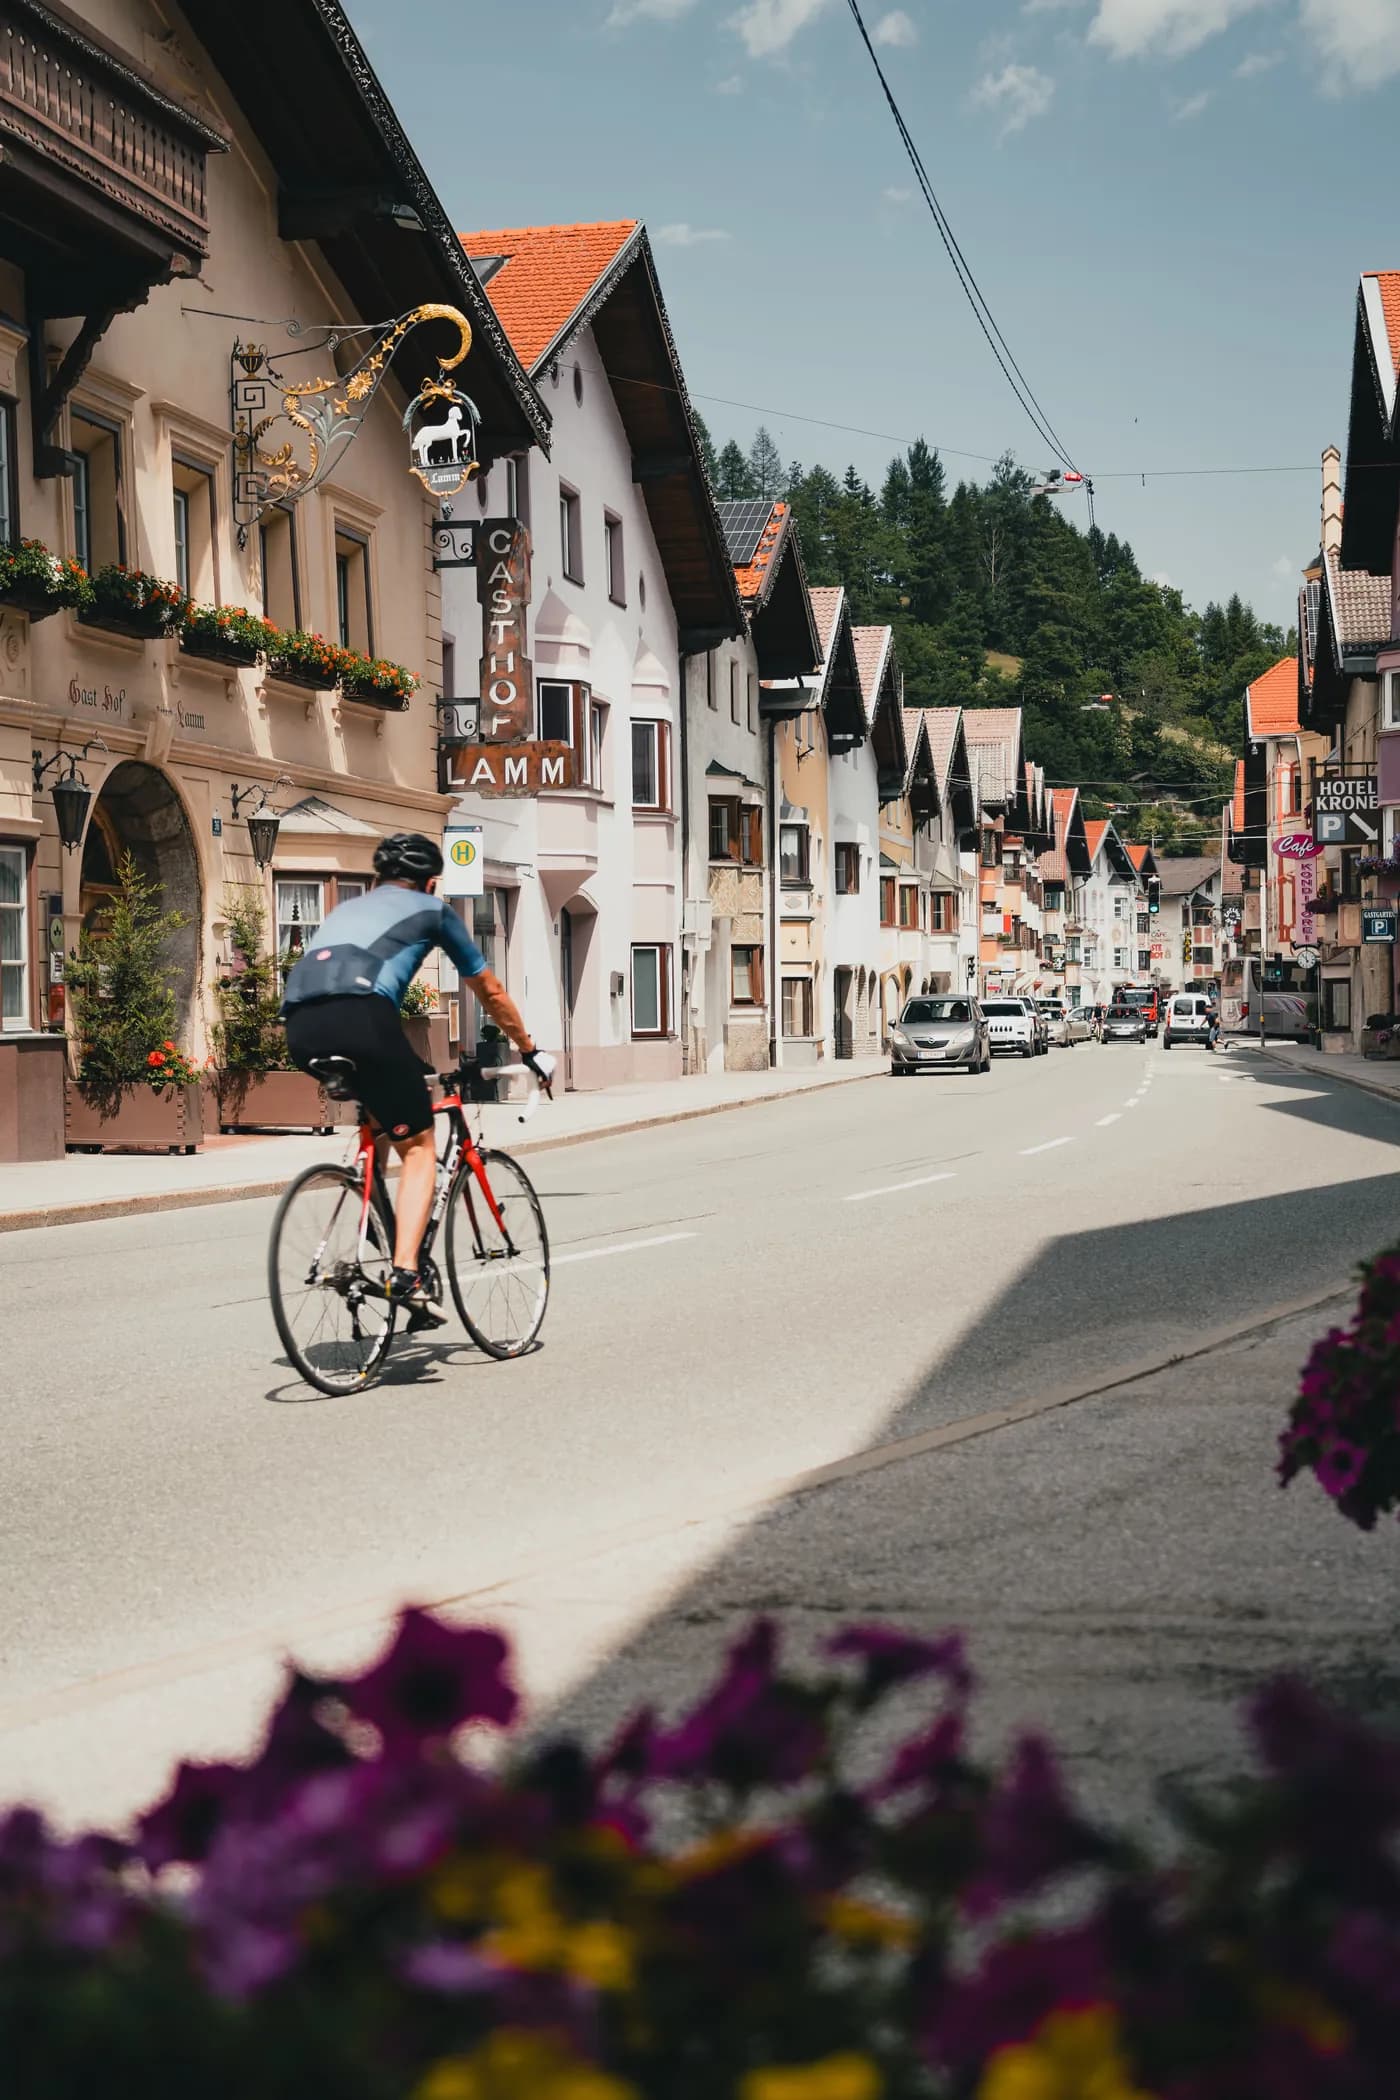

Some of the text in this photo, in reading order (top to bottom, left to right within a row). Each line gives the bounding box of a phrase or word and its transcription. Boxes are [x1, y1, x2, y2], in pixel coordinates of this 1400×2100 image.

[431, 472, 460, 484] Lamm
[446, 757, 565, 785] LAMM
[1319, 780, 1376, 796] HOTEL
[1316, 795, 1378, 811] KRONE
[1322, 816, 1341, 839] P
[456, 845, 470, 861] H
[1374, 921, 1385, 933] P
